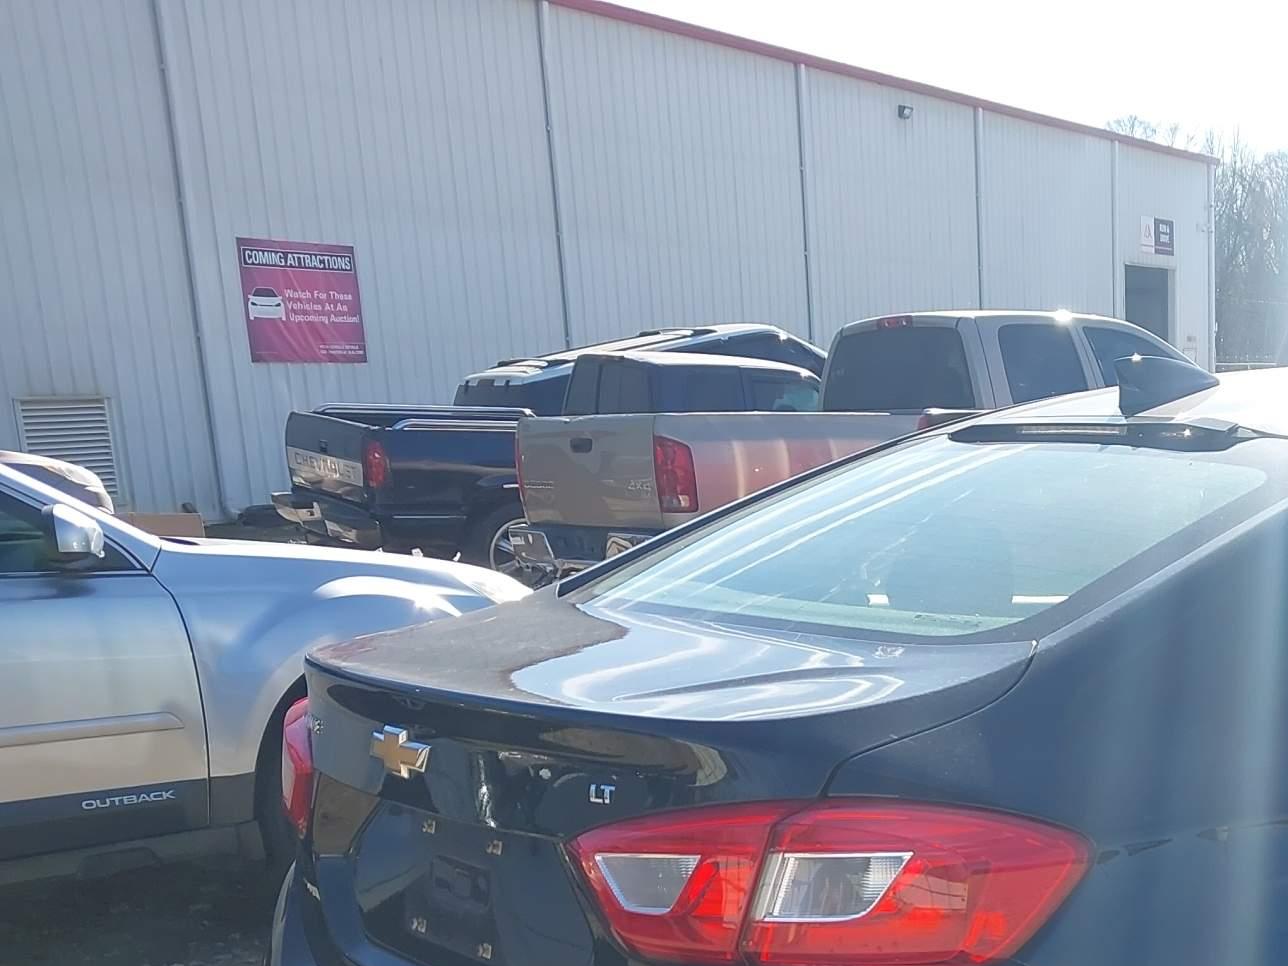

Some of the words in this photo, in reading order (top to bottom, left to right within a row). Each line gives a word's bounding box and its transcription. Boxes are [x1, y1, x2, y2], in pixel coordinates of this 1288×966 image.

[245, 250, 285, 266] COMING
[287, 254, 351, 270] ATTRACTIONS
[284, 289, 312, 299] Watch
[314, 290, 327, 299] For
[328, 290, 353, 300] These
[286, 300, 322, 311] Vehicles
[325, 302, 335, 311] At
[336, 302, 349, 312] An
[289, 312, 329, 324] Upcoming
[330, 313, 360, 323] Auction!
[82, 790, 176, 810] OUTBACK
[589, 784, 616, 805] LT
